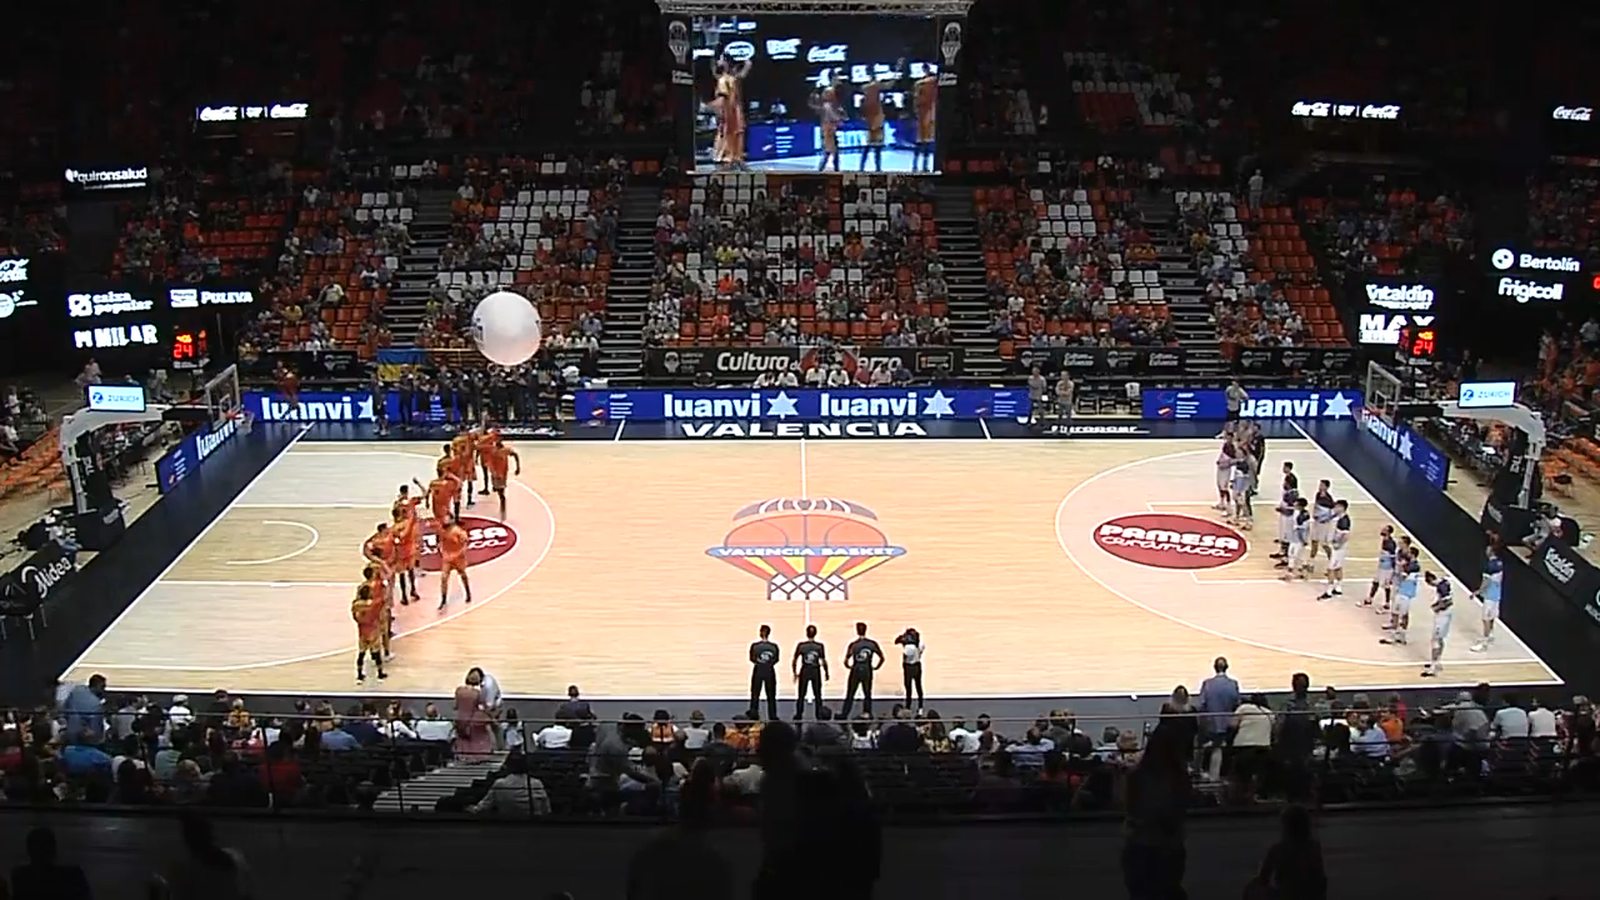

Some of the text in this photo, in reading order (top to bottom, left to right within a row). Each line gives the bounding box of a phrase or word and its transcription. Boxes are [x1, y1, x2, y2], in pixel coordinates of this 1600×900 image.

[1519, 253, 1580, 272] Bertolín
[1498, 277, 1564, 303] Frigicoll
[174, 343, 193, 358] 24
[1413, 340, 1433, 355] 24
[717, 352, 790, 371] Cultura
[664, 393, 760, 418] luanvi
[820, 393, 917, 417] luanvi
[1239, 394, 1319, 418] uanvi
[681, 422, 927, 437] VALENCIA
[1099, 524, 1239, 550] PAMESA
[719, 547, 895, 556] VALENCIA BASKET
